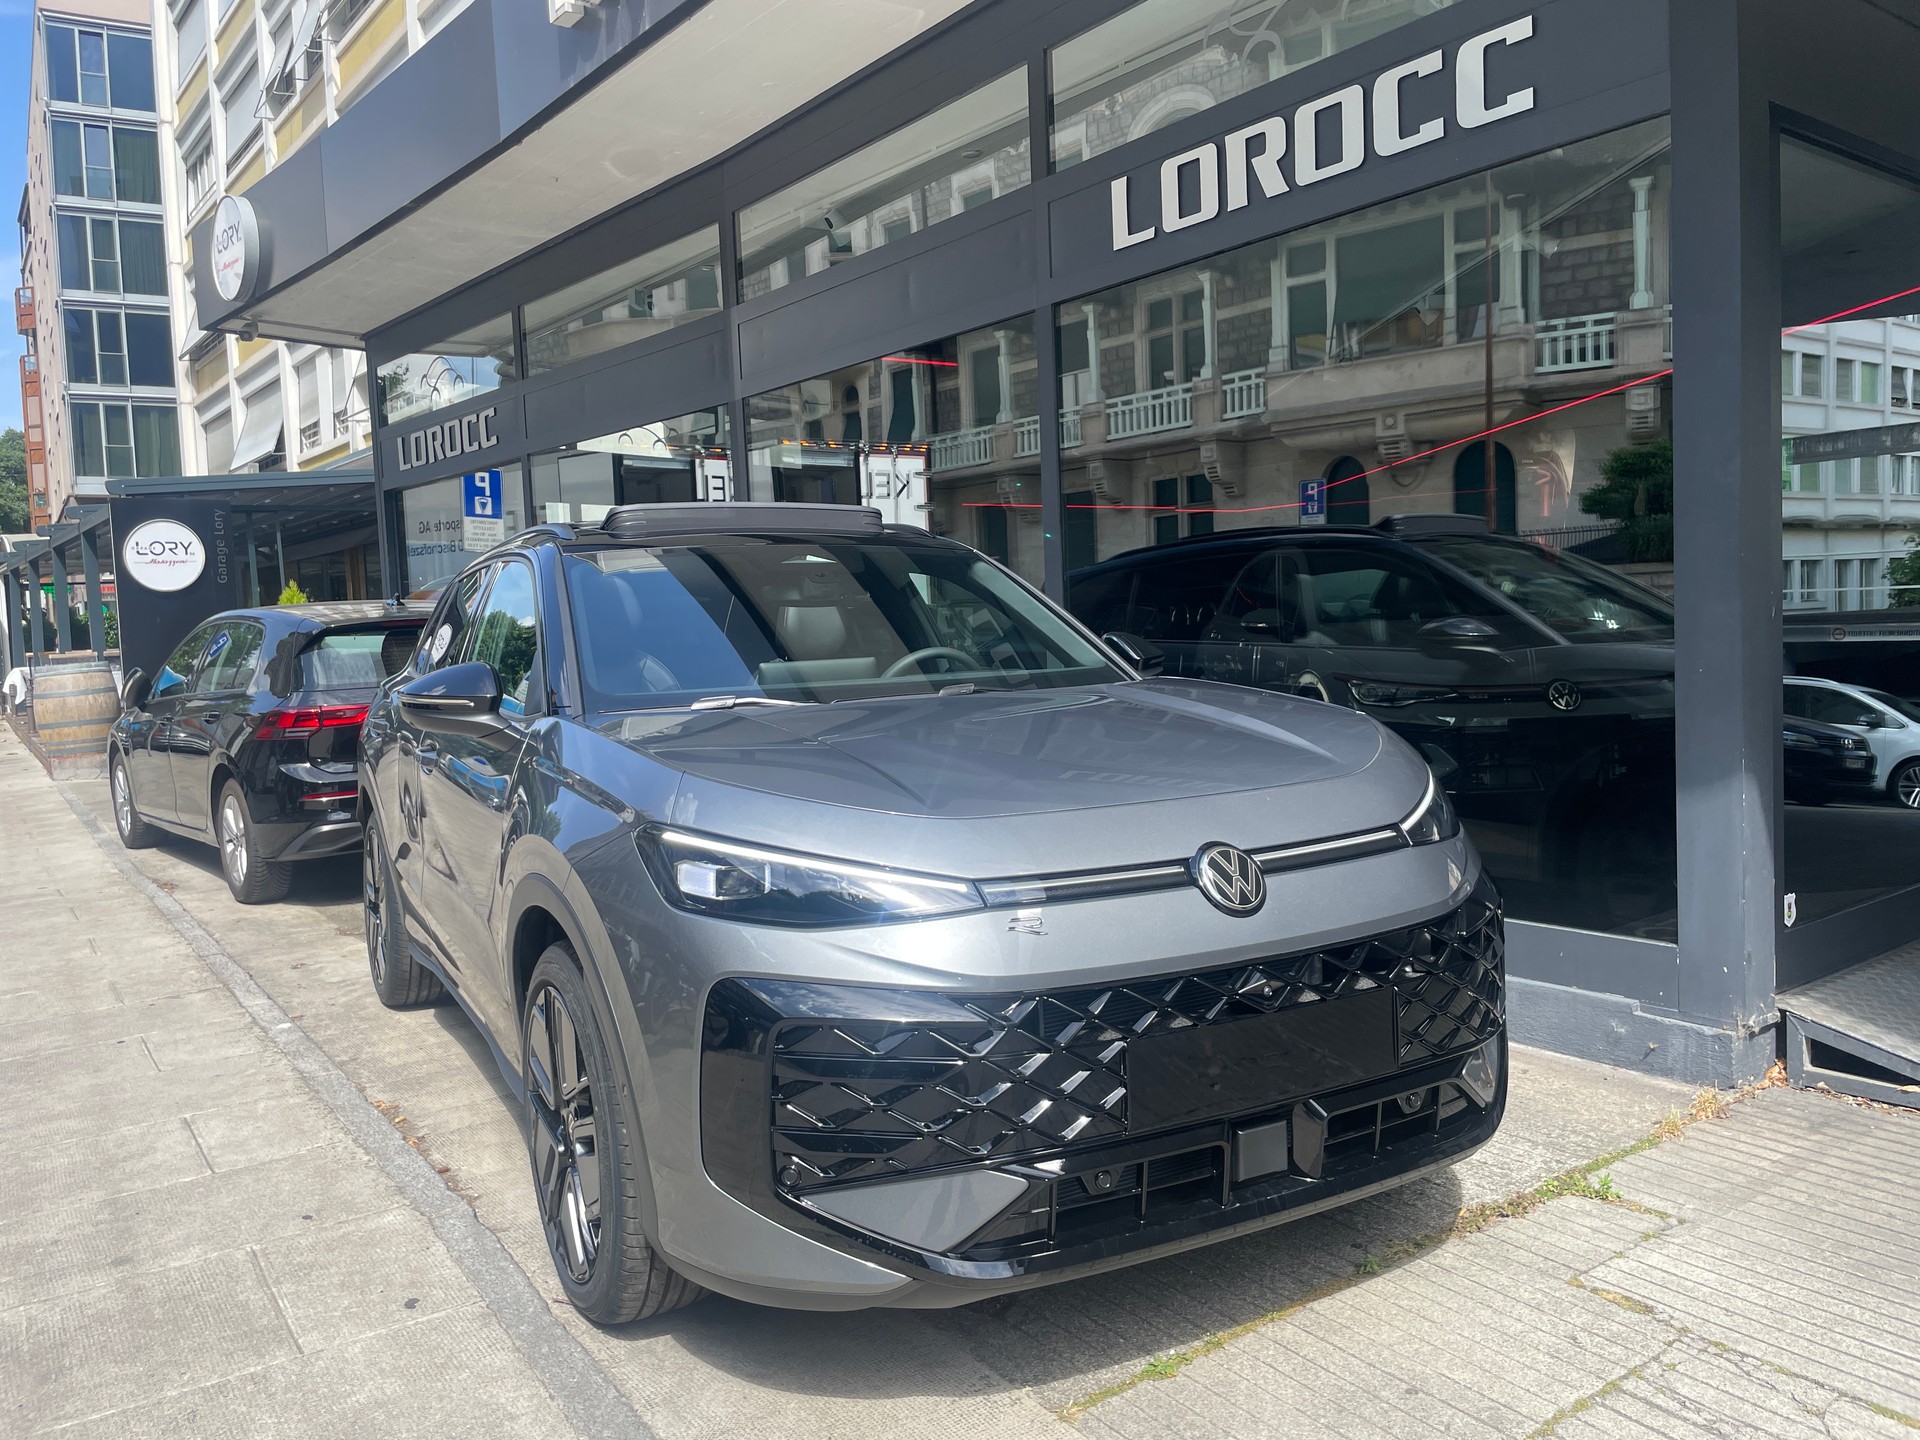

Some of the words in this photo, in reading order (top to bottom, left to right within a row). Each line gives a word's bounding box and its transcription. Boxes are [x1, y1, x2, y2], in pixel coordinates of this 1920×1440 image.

[1110, 15, 1534, 251] LOROCC
[216, 221, 240, 254] LORY
[397, 407, 498, 471] LOROCC
[214, 509, 226, 535] Lory
[135, 541, 192, 556] LORY
[216, 540, 228, 583] Garage
